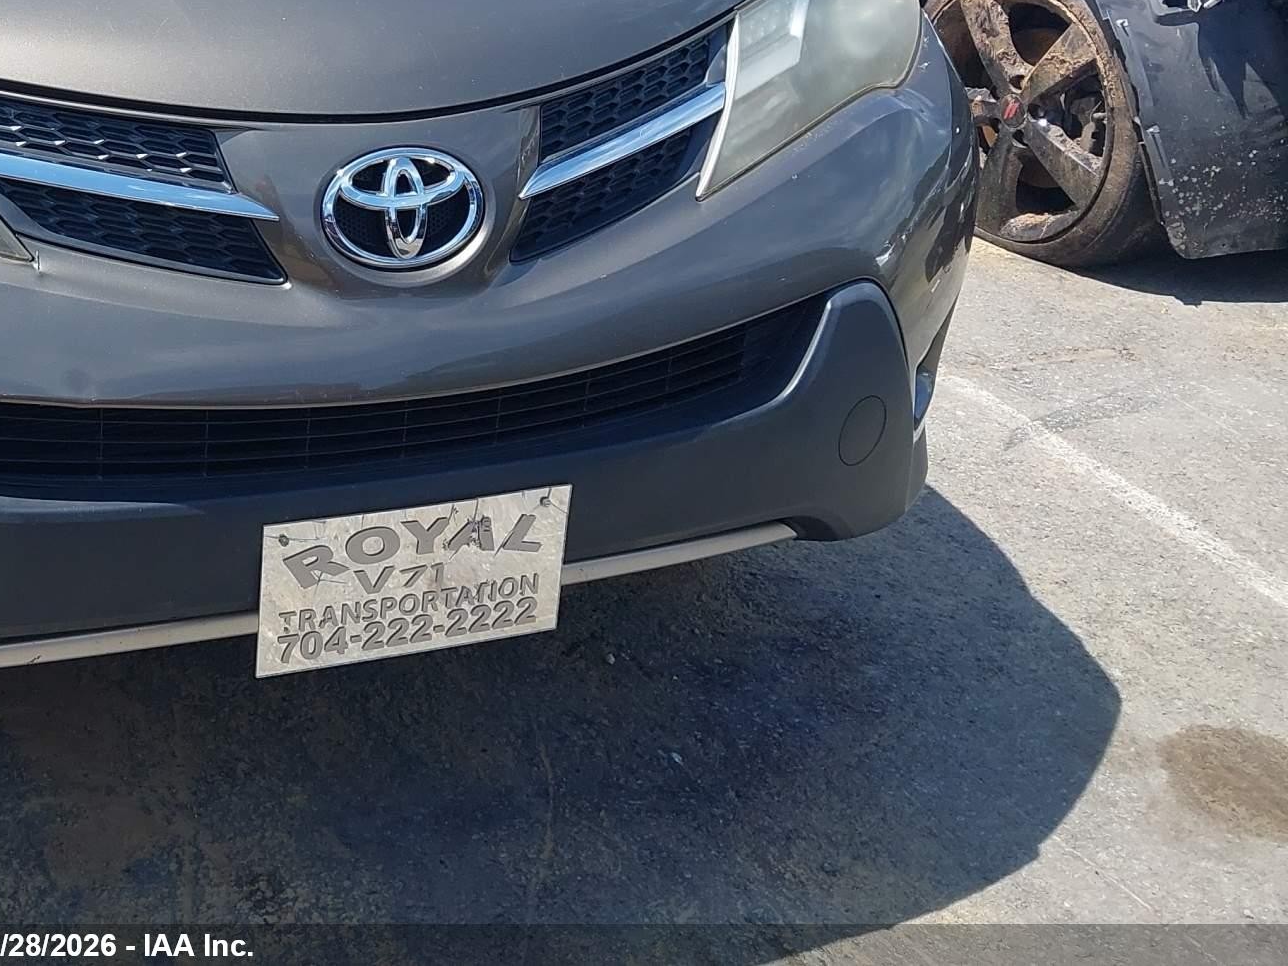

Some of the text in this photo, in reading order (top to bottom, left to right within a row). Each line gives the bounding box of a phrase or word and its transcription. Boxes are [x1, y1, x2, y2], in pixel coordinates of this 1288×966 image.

[282, 513, 543, 589] ROYAL
[277, 597, 538, 664] 704-222-2222
[278, 573, 539, 634] TRANSPORTATION
